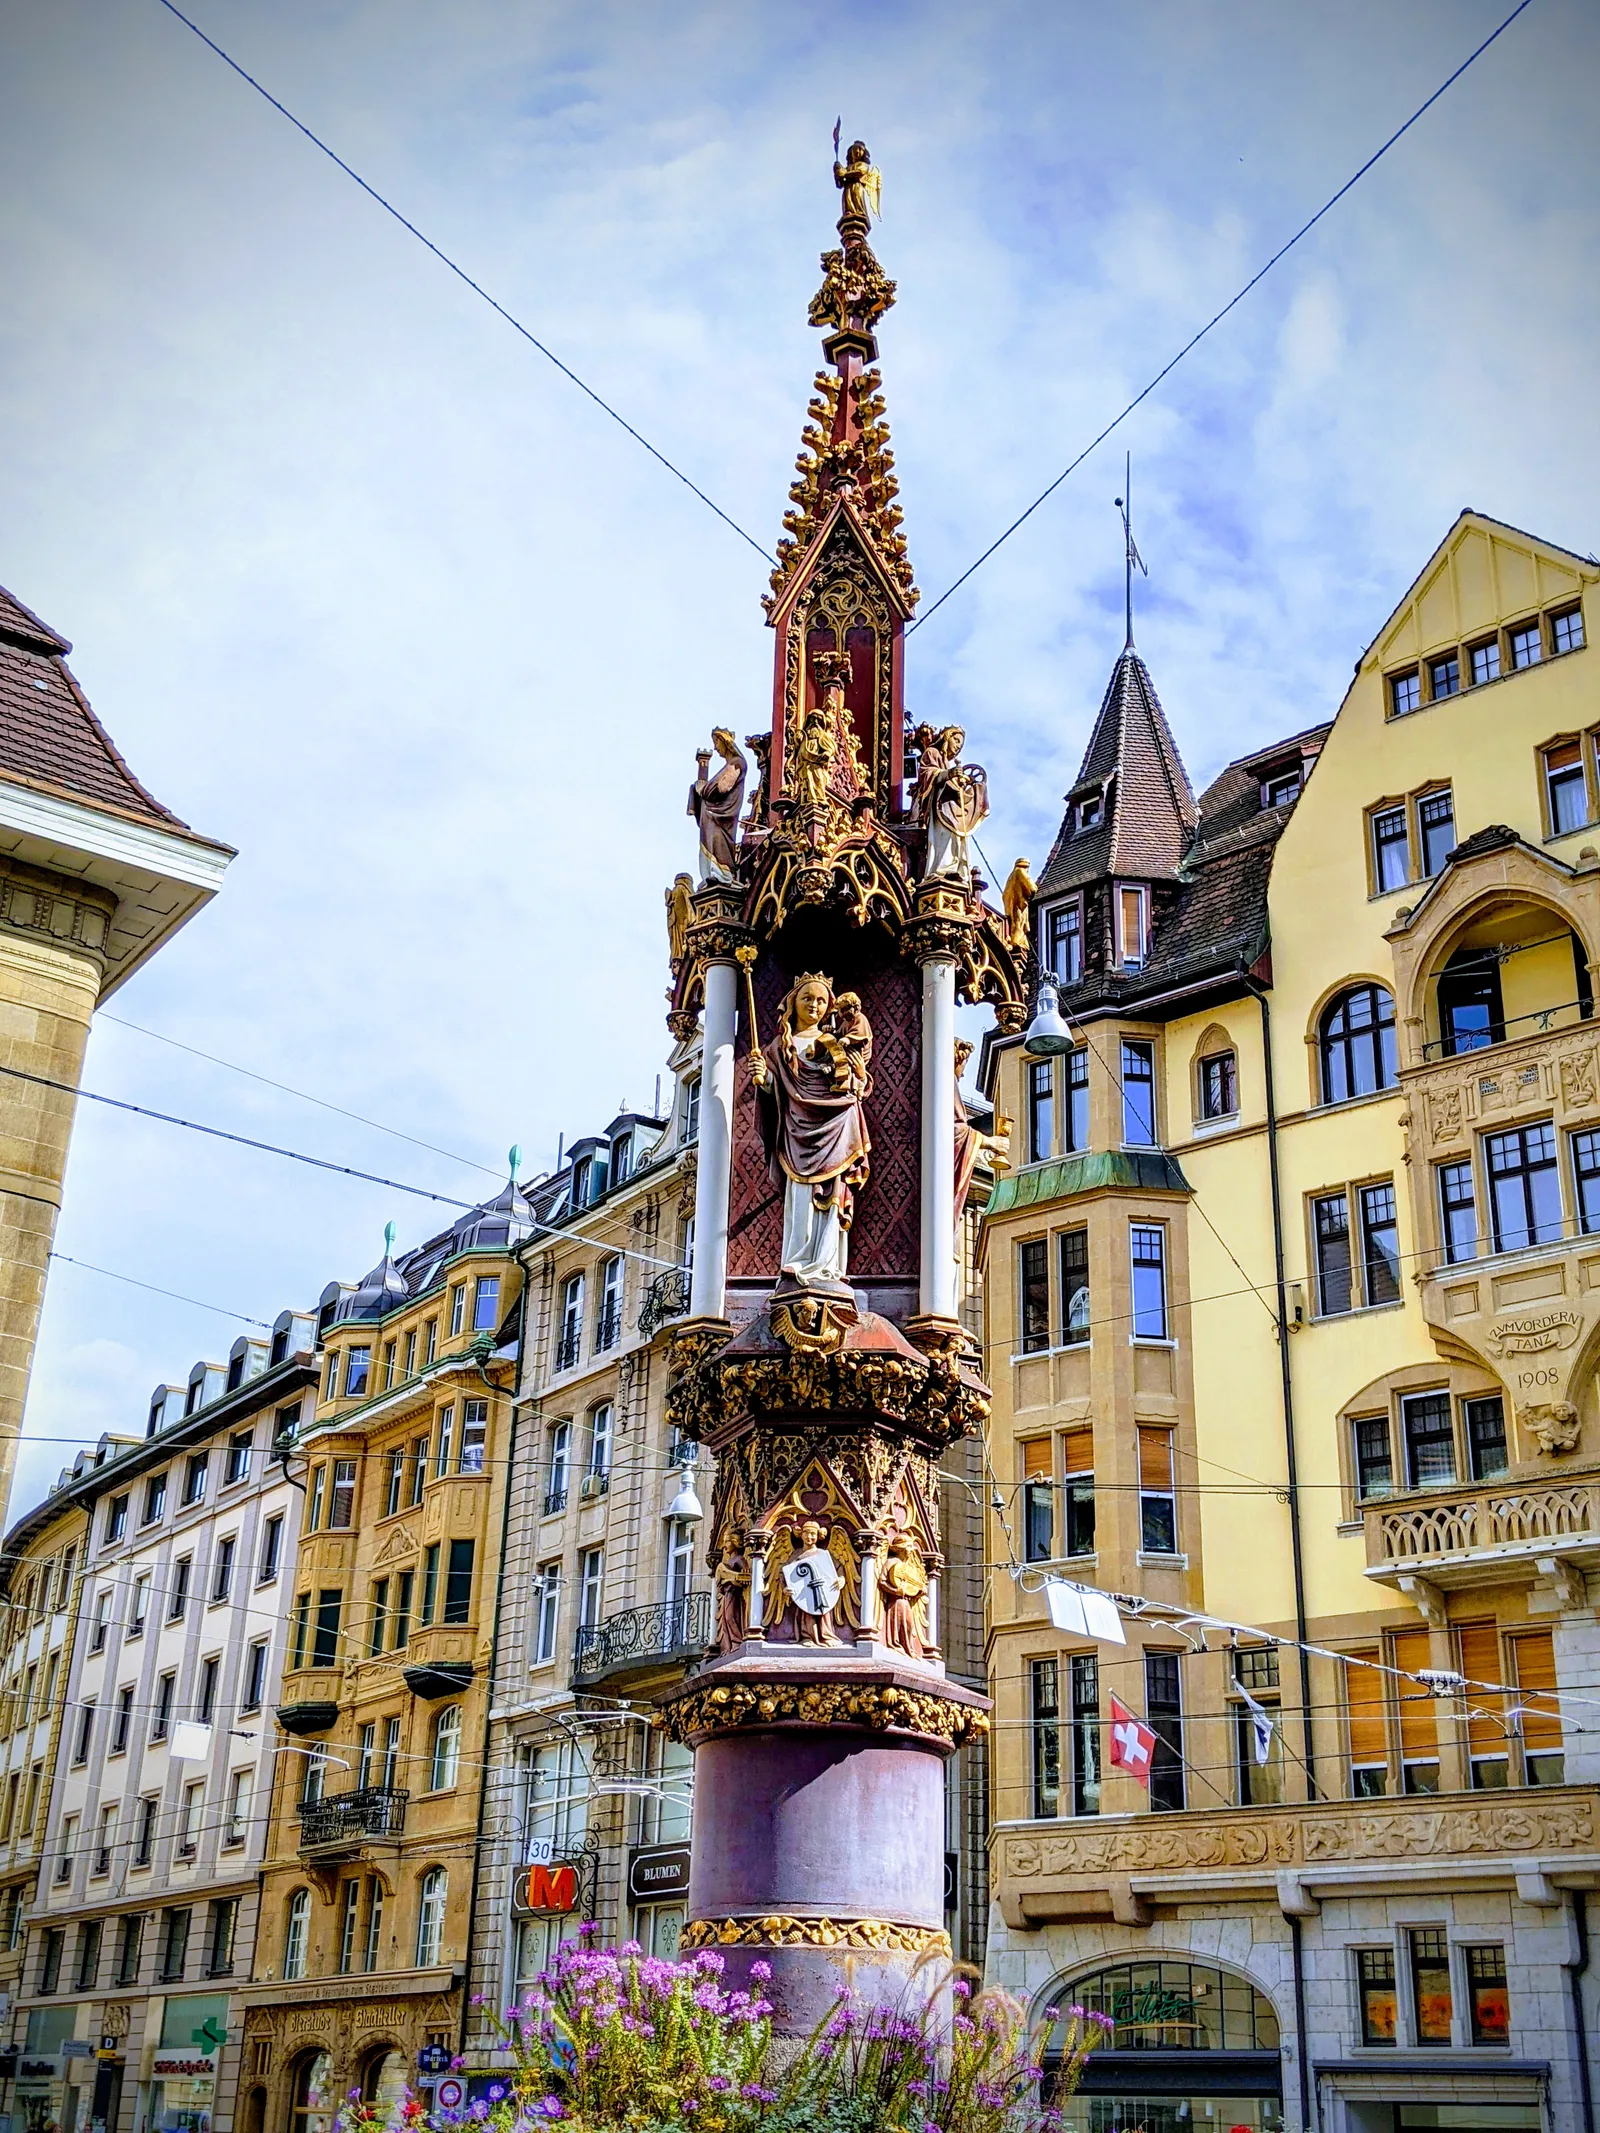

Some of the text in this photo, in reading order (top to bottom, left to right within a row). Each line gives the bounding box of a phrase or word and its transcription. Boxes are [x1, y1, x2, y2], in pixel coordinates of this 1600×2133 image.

[1514, 1311, 1580, 1332] VORDERN
[1515, 1333, 1552, 1350] TANZ
[1518, 1367, 1559, 1389] 1908
[531, 1842, 550, 1860] 30
[644, 1863, 682, 1882] BLUMEN
[528, 1864, 576, 1911] M
[105, 2038, 114, 2049] D
